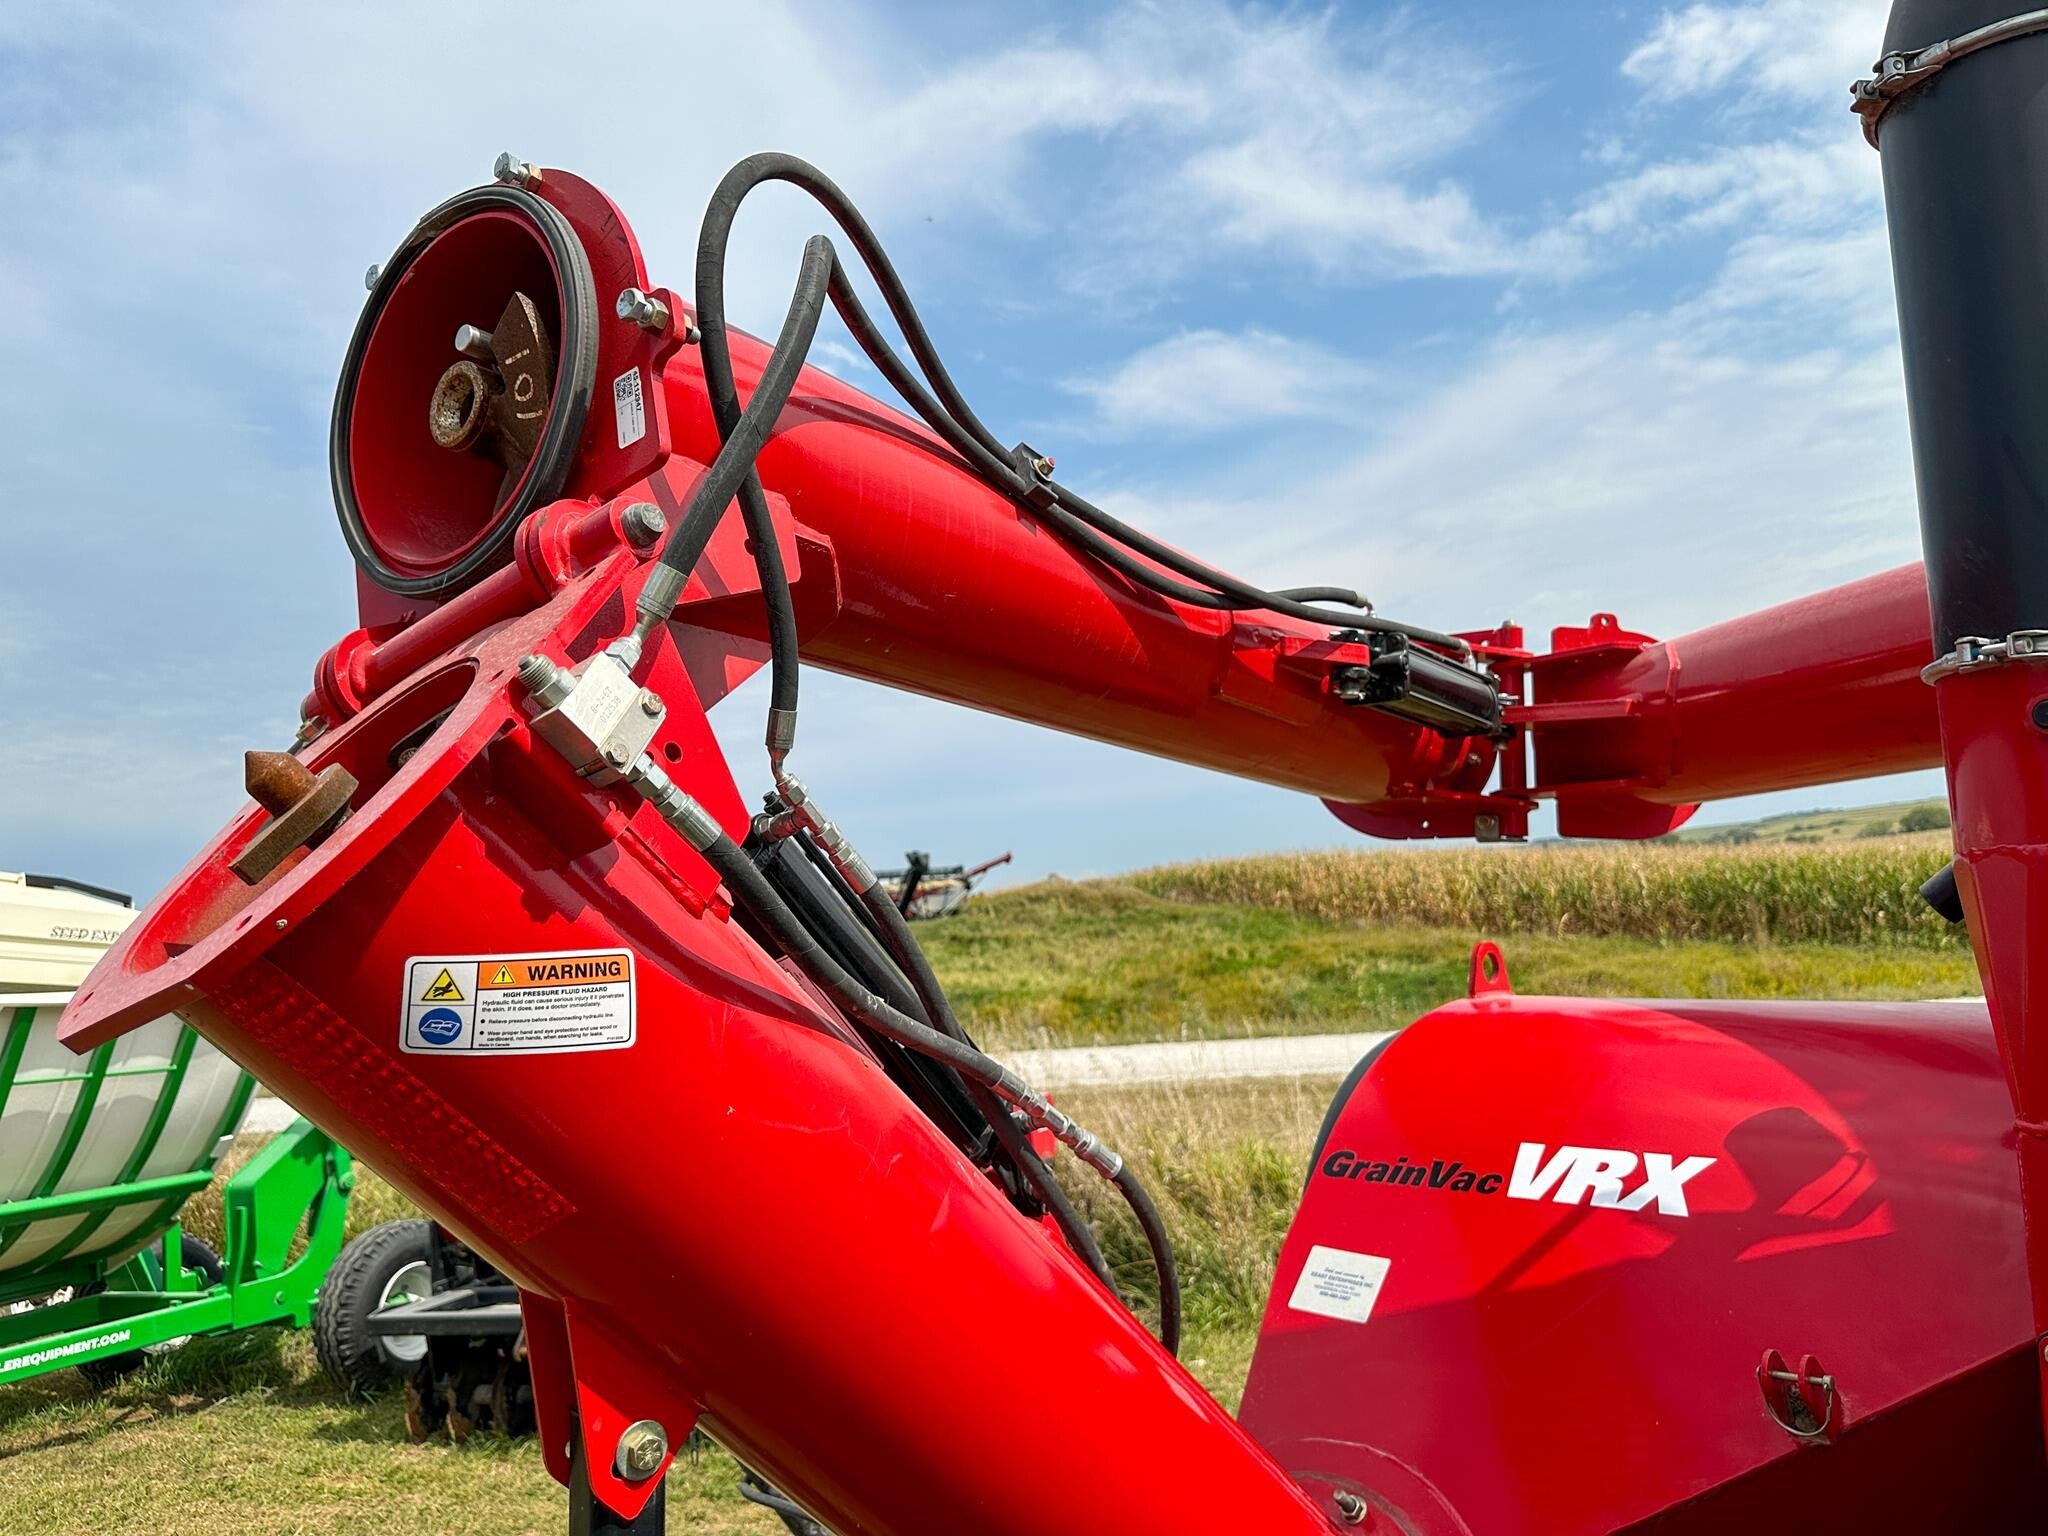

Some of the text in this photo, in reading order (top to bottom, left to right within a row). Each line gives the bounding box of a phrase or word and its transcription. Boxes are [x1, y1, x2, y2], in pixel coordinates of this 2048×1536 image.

[528, 961, 621, 982] WARNING
[1321, 1141, 1718, 1217] GrainVac VRX
